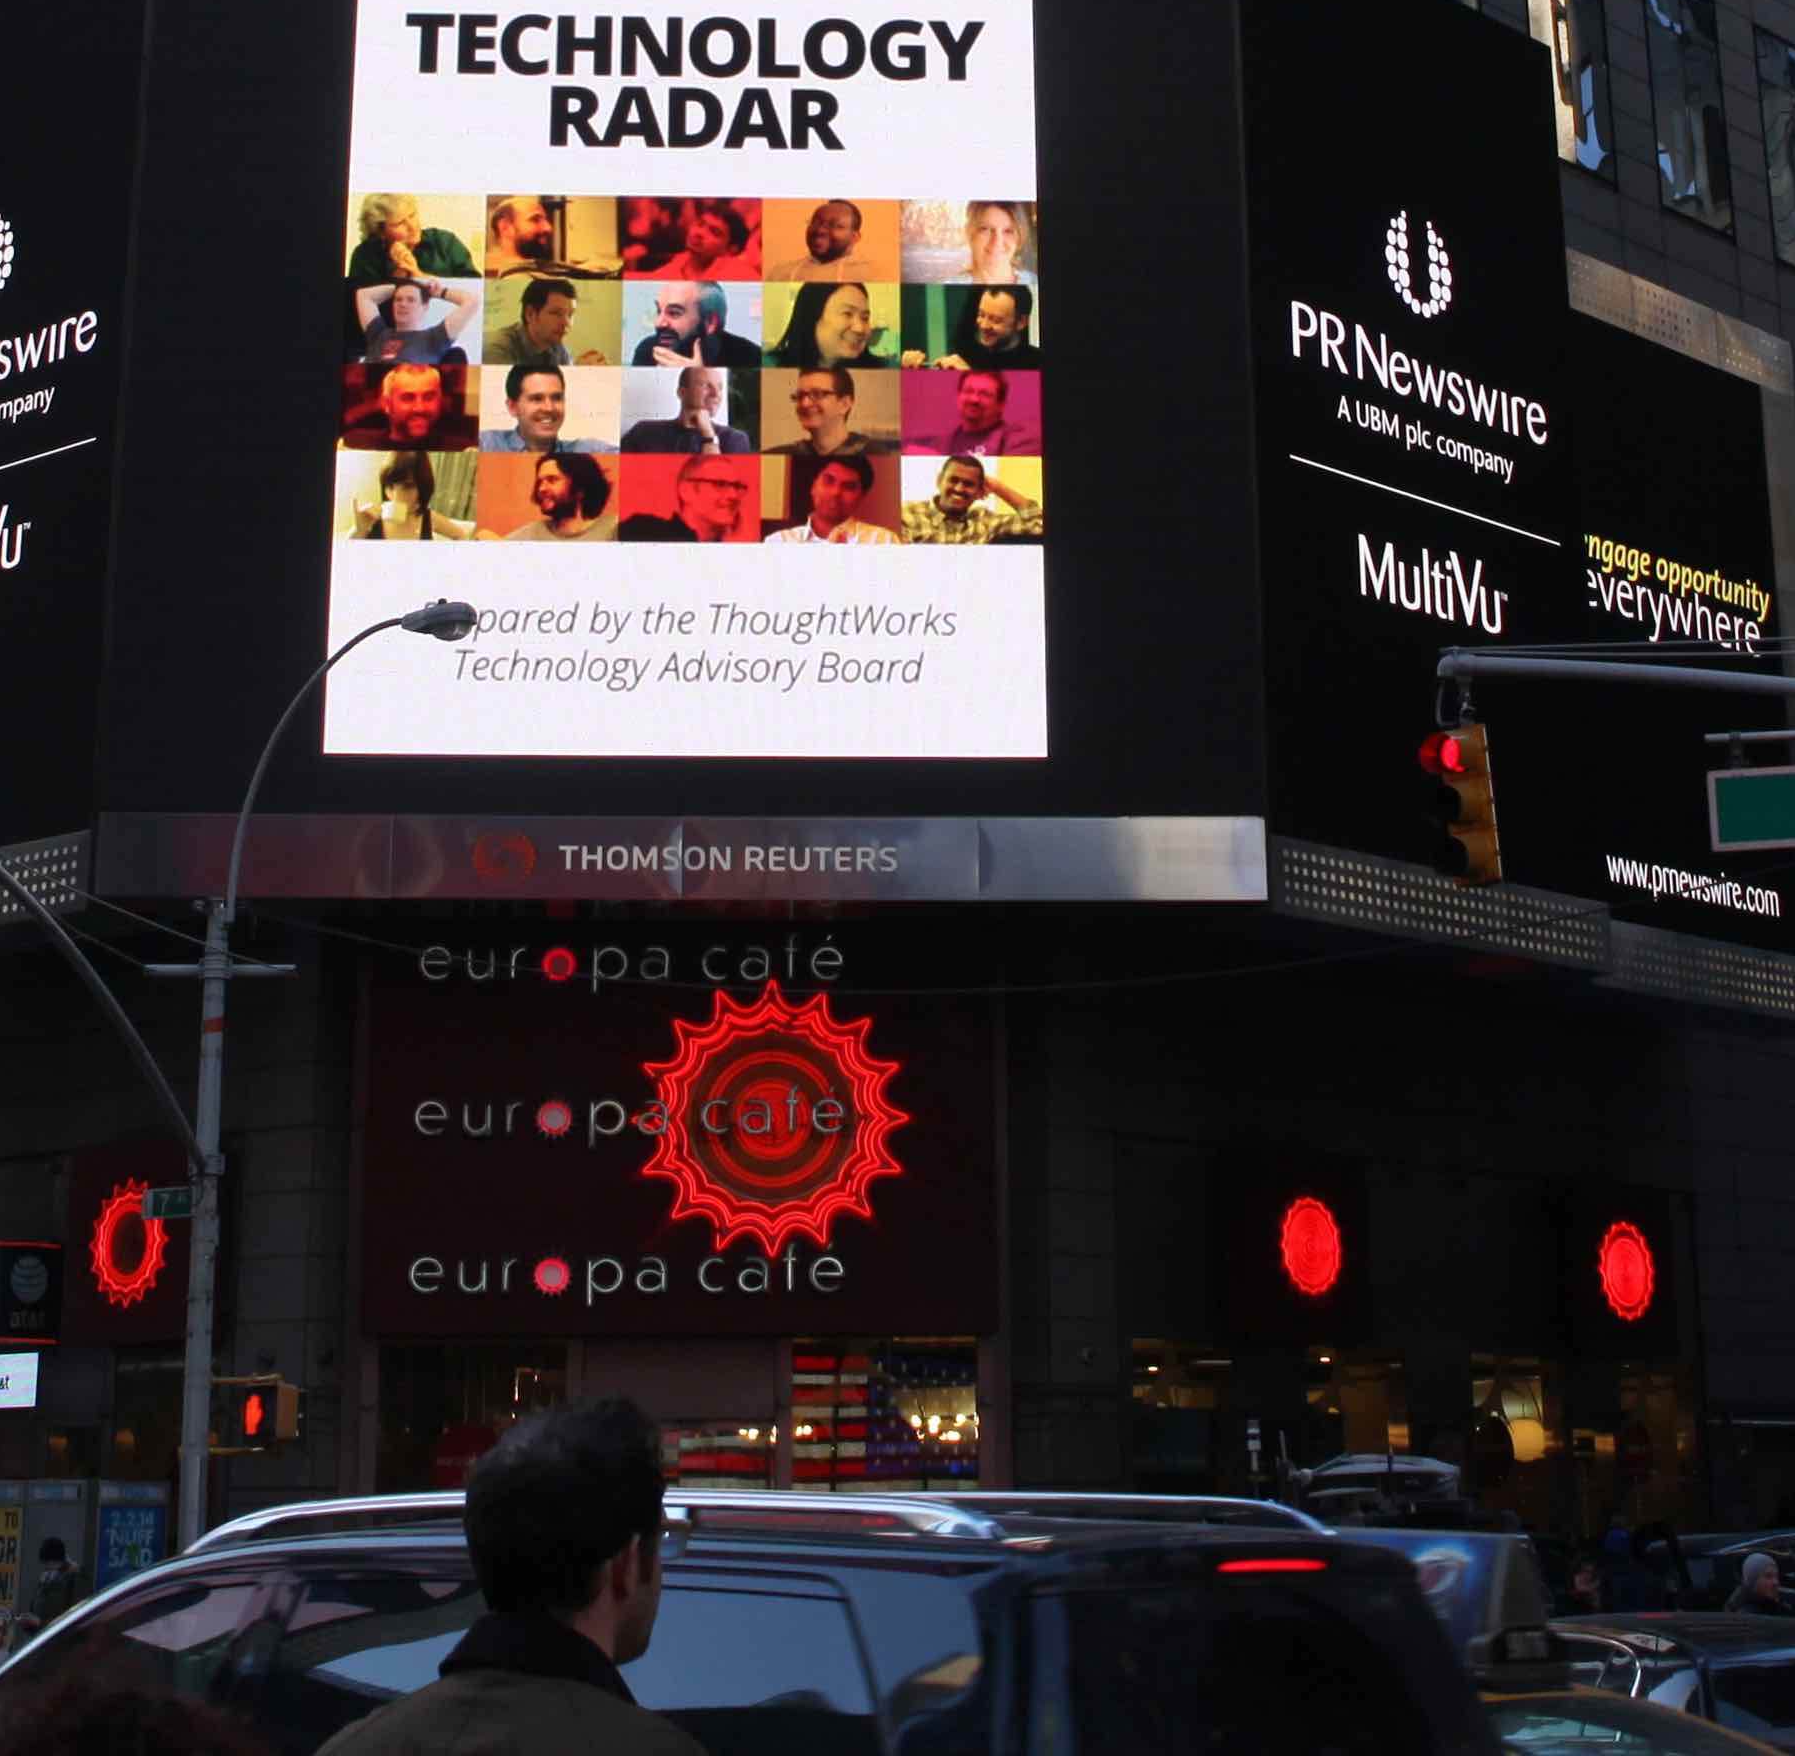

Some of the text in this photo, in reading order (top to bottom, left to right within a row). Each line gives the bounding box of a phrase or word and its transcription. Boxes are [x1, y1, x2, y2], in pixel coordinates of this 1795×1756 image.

[405, 13, 985, 82] TECHNOLOGY
[549, 85, 846, 151] RADAR
[1291, 300, 1547, 445] PR Newswire
[1337, 395, 1514, 485] A UBM plc company
[1583, 533, 1770, 624] ngage opportunity
[589, 601, 633, 644] by
[642, 602, 696, 635] the
[706, 603, 958, 641] ThoughtWorks
[455, 648, 923, 692] Technology Advisory Board
[559, 844, 899, 875] THOMSON REUTERS
[1606, 854, 1780, 917] www.prnewswire.com
[418, 935, 845, 993] europa café
[414, 1085, 847, 1147] europa café
[409, 1244, 846, 1306] europa café
